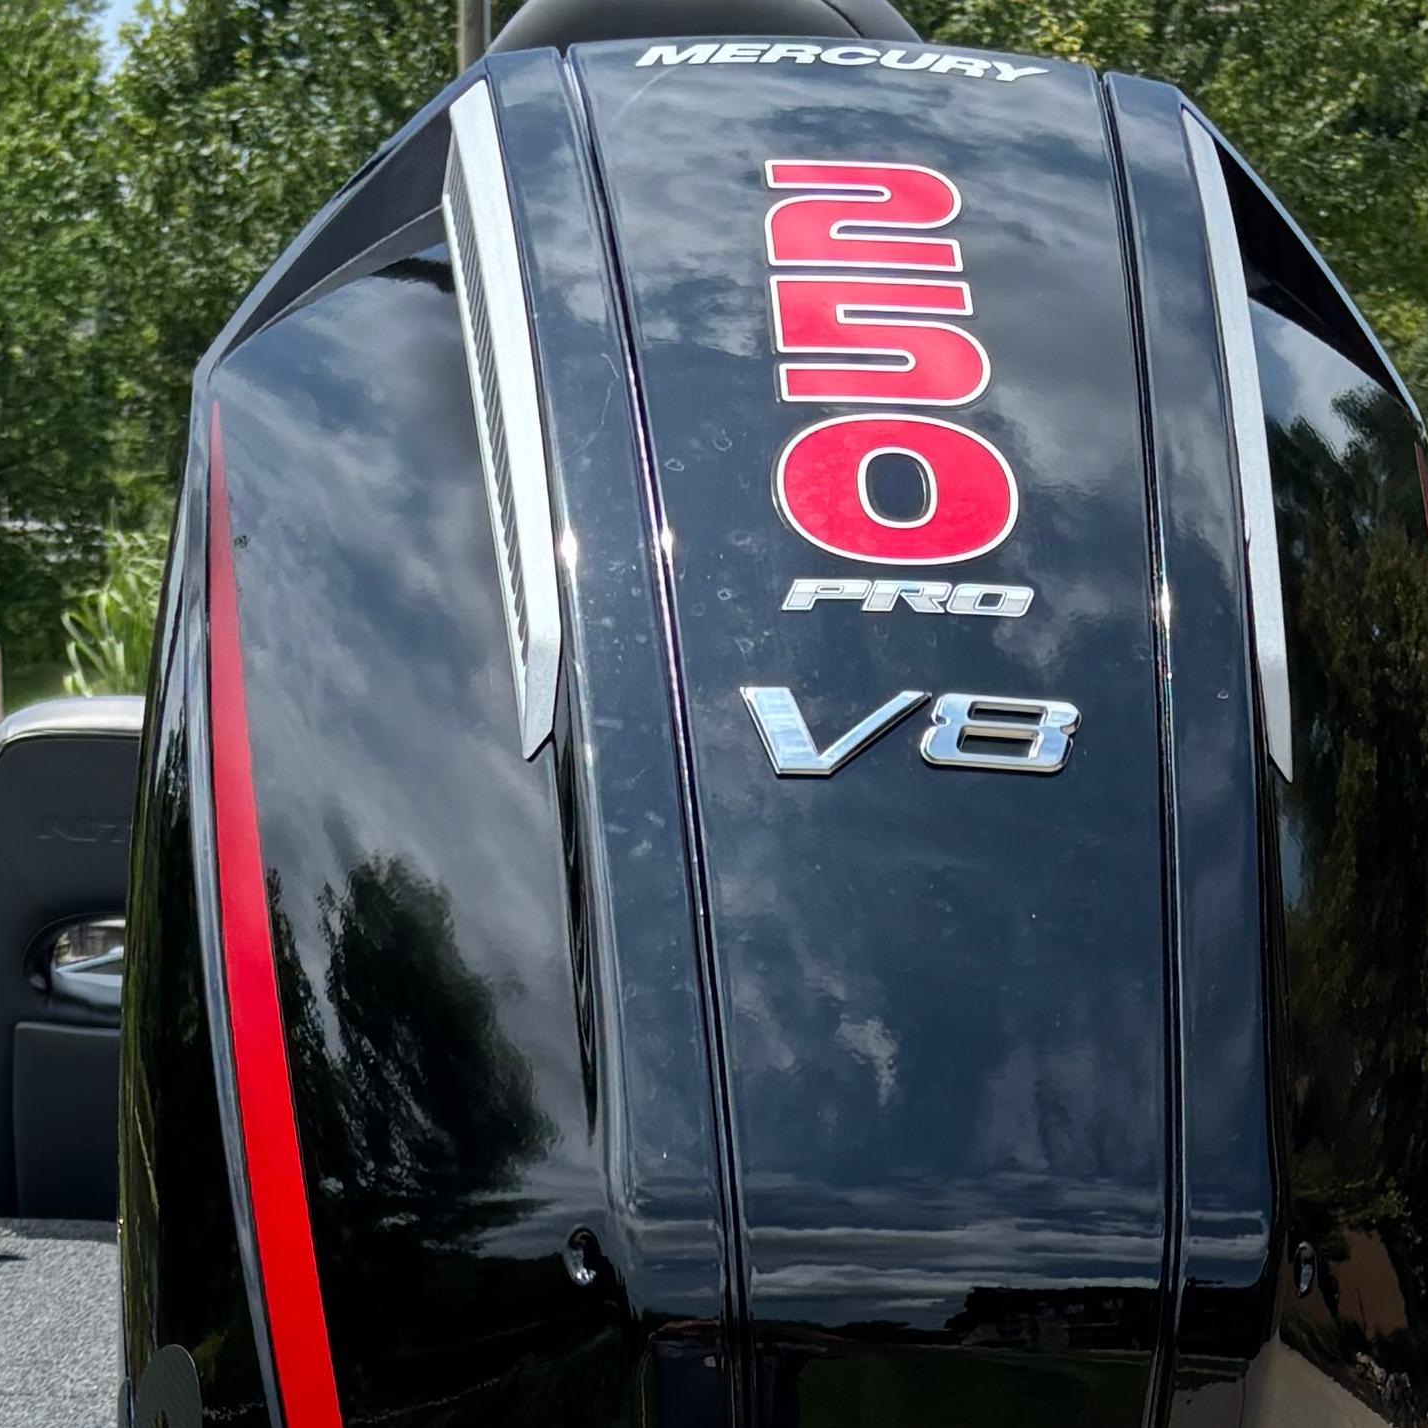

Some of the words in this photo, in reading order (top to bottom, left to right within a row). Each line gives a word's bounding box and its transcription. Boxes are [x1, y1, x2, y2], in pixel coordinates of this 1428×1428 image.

[635, 43, 1051, 83] MERCURY
[764, 159, 1020, 566] 250
[780, 577, 1035, 618] PRO
[739, 685, 1083, 779] V8
